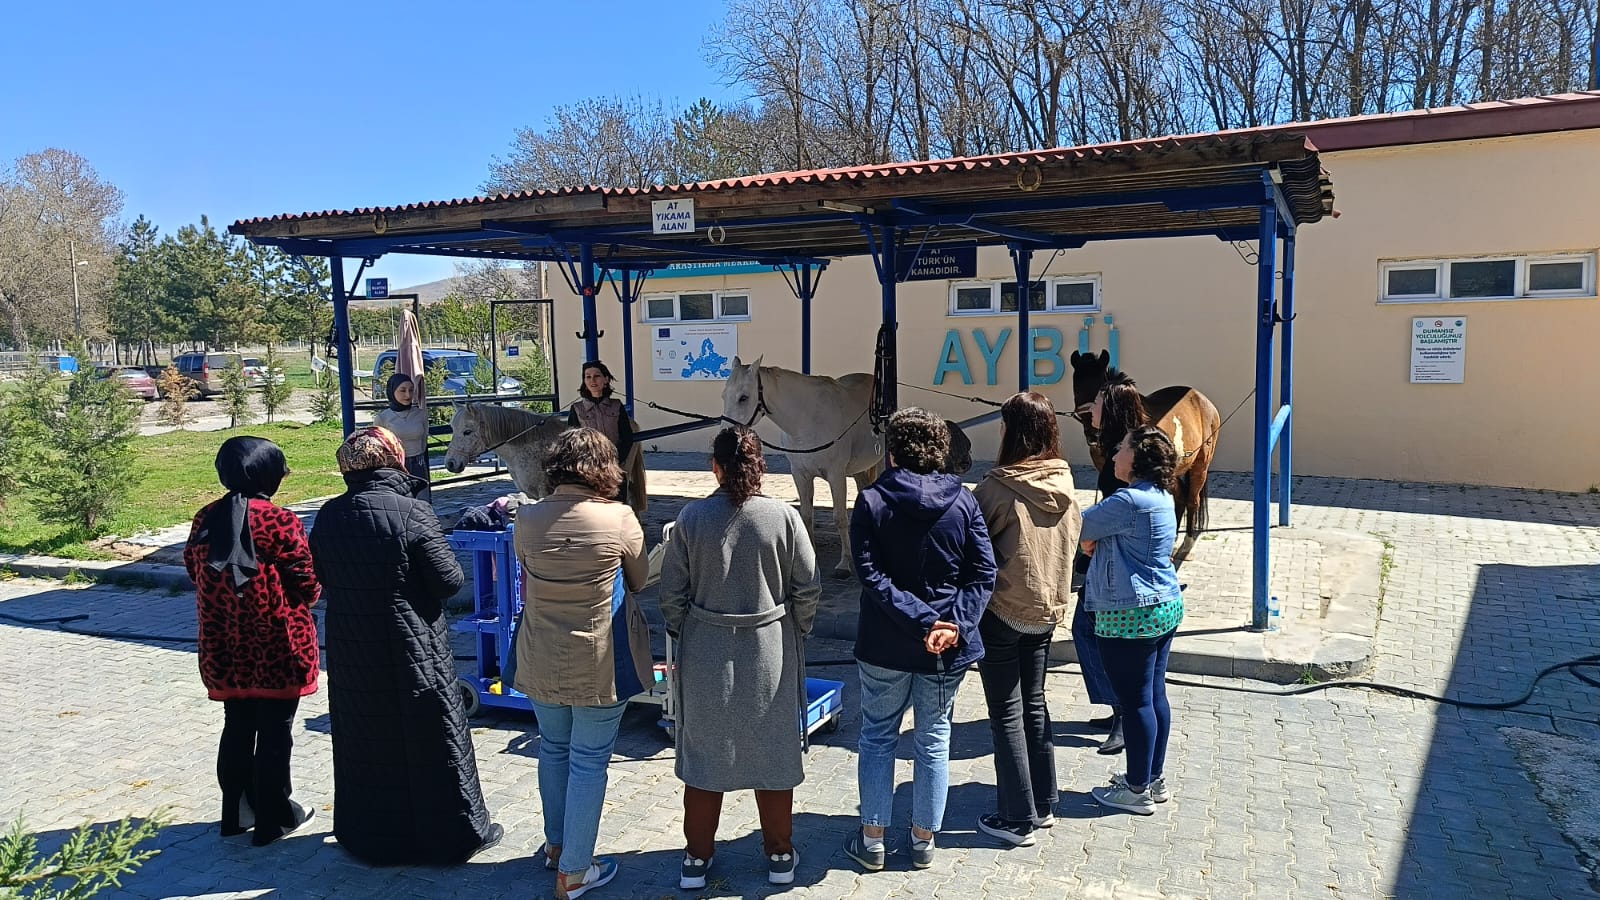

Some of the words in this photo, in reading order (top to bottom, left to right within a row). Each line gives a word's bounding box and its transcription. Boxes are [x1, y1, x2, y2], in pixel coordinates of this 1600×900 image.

[667, 202, 678, 210] AT
[656, 212, 691, 221] YIKAMA
[661, 222, 687, 231] ALANI
[917, 255, 956, 266] TÜRK'ÜN
[933, 315, 1120, 386] AYBÜ
